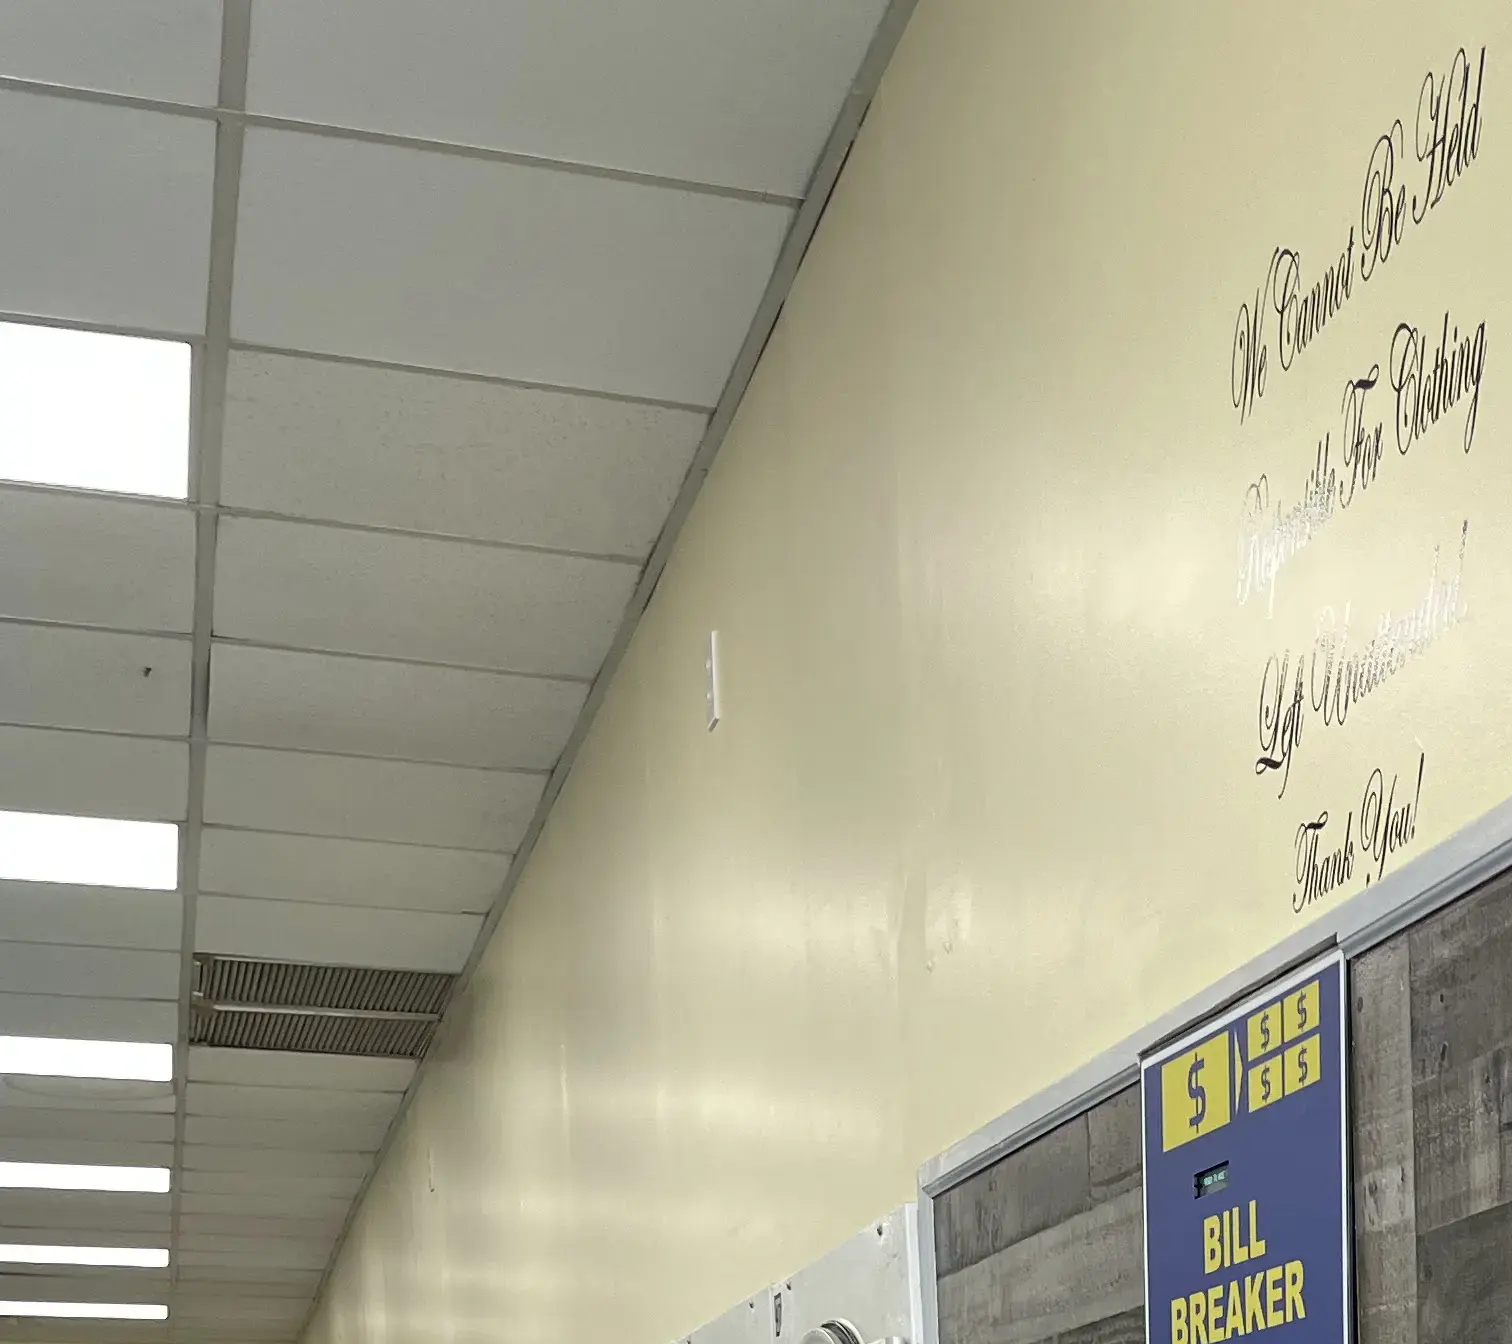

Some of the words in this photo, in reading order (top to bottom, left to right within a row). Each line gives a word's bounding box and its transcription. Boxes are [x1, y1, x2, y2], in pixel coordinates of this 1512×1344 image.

[1232, 246, 1279, 424] We
[1274, 226, 1355, 370] Cannot
[1361, 119, 1406, 281] Be
[1412, 46, 1486, 224] Held
[1342, 364, 1384, 508] For
[1390, 311, 1488, 454] Clothing
[1255, 650, 1305, 800] Left
[1293, 811, 1355, 913] Thank
[1360, 752, 1425, 887] You!
[1202, 1200, 1267, 1275] BILL
